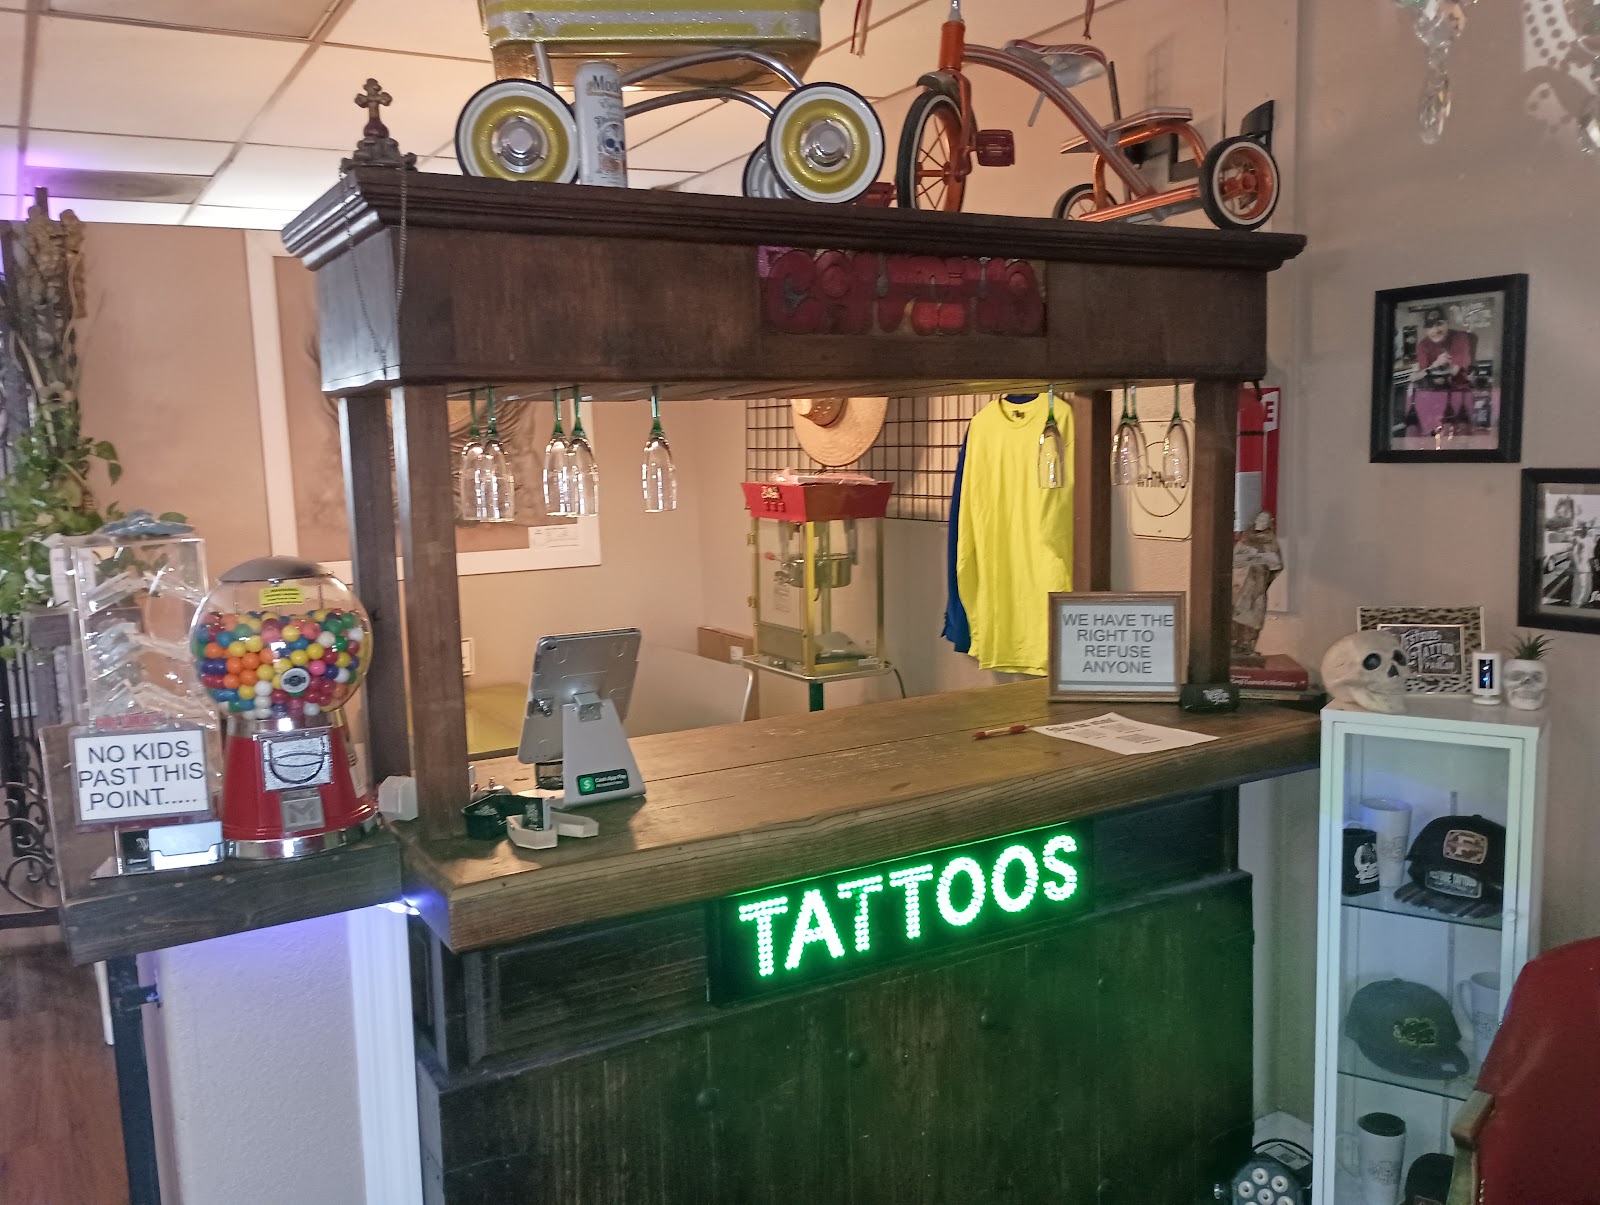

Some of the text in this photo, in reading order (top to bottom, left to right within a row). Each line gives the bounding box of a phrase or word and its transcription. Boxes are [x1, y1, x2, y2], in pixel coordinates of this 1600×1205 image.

[1062, 613, 1174, 627] WE HAVE THE
[1076, 629, 1154, 643] RIGHT TO
[1084, 645, 1151, 658] REFUSE
[1082, 661, 1152, 674] ANYONE
[88, 740, 190, 765] NO KIDS
[78, 762, 204, 789] PAST THIS
[738, 834, 1078, 978] TATTOOS
